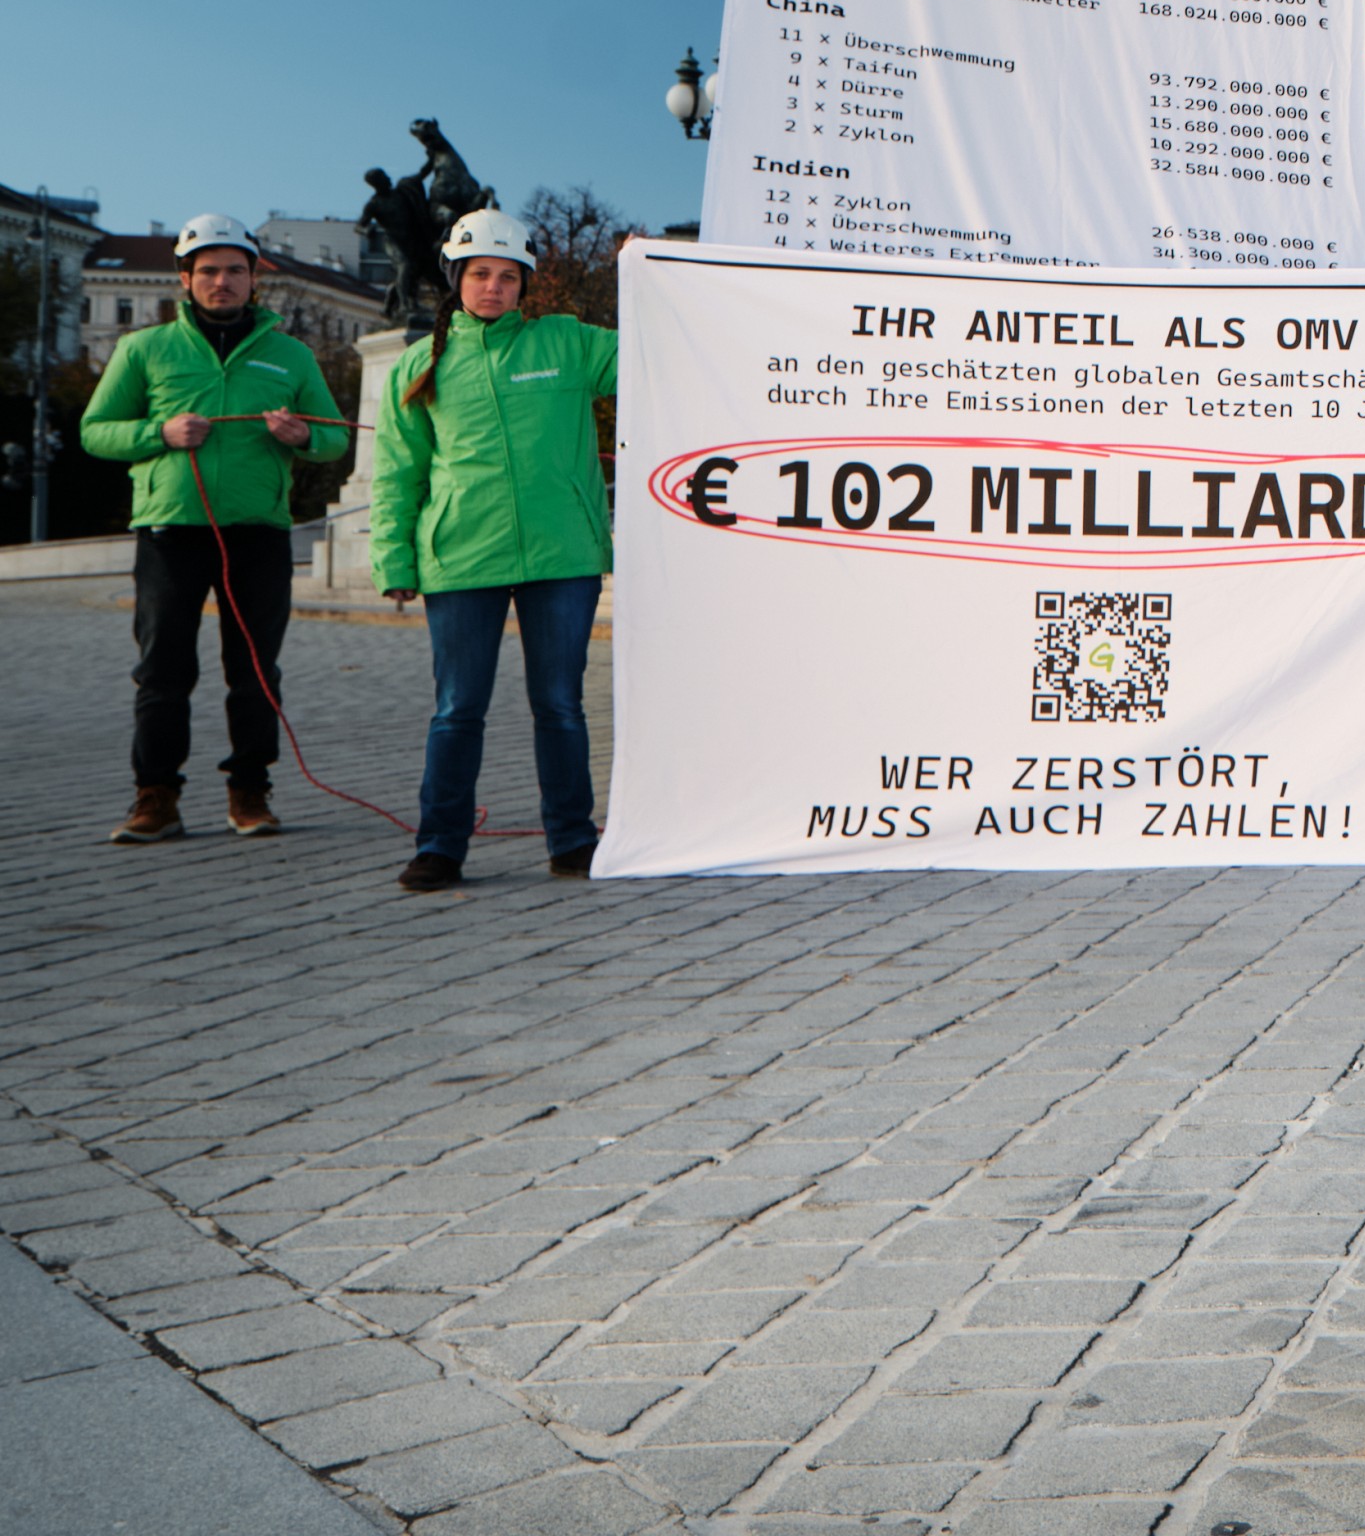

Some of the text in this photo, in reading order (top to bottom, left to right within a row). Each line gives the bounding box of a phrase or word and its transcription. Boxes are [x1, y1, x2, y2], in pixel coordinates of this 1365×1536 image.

[1139, 1, 1329, 31] 168.024.000.000 €
[780, 27, 1015, 73] 11 Überschwemmung
[789, 51, 918, 81] 9 Taifun
[787, 74, 904, 99] 4 Dürre
[1149, 72, 1330, 101] 93.792.000.000 €
[786, 96, 904, 121] 3 Sturm
[1150, 94, 1331, 124] 13.290.000.000 €
[784, 119, 915, 145] 2 Zyklon
[1150, 116, 1332, 145] 15.680.000.000 €
[1150, 136, 1332, 167] 10.292.000.000 €
[752, 155, 851, 180] Indien
[1150, 158, 1333, 189] 32.584.000.000 €
[766, 188, 912, 212] 12 Zyklon
[765, 211, 1012, 246] 10 Überschwemmung
[1151, 226, 1337, 254] 26.538.000.000 €
[852, 305, 1358, 350] IHR ANTEIL ALS OMV
[767, 356, 799, 373] an
[816, 353, 864, 376] den
[882, 358, 1057, 383] geschätzten
[1074, 363, 1200, 389] globalen
[767, 382, 847, 406] durch
[865, 387, 929, 409] Ihre
[946, 390, 1104, 415] Emissionen
[1121, 394, 1169, 416] der
[1185, 396, 1293, 418] letzten
[1311, 399, 1341, 419] 10
[686, 456, 739, 527] €
[777, 460, 935, 532] 102
[881, 746, 1288, 798] WER ZERSTÖRT,
[807, 803, 1350, 838] MUSS AUCH ZAHLEN!
